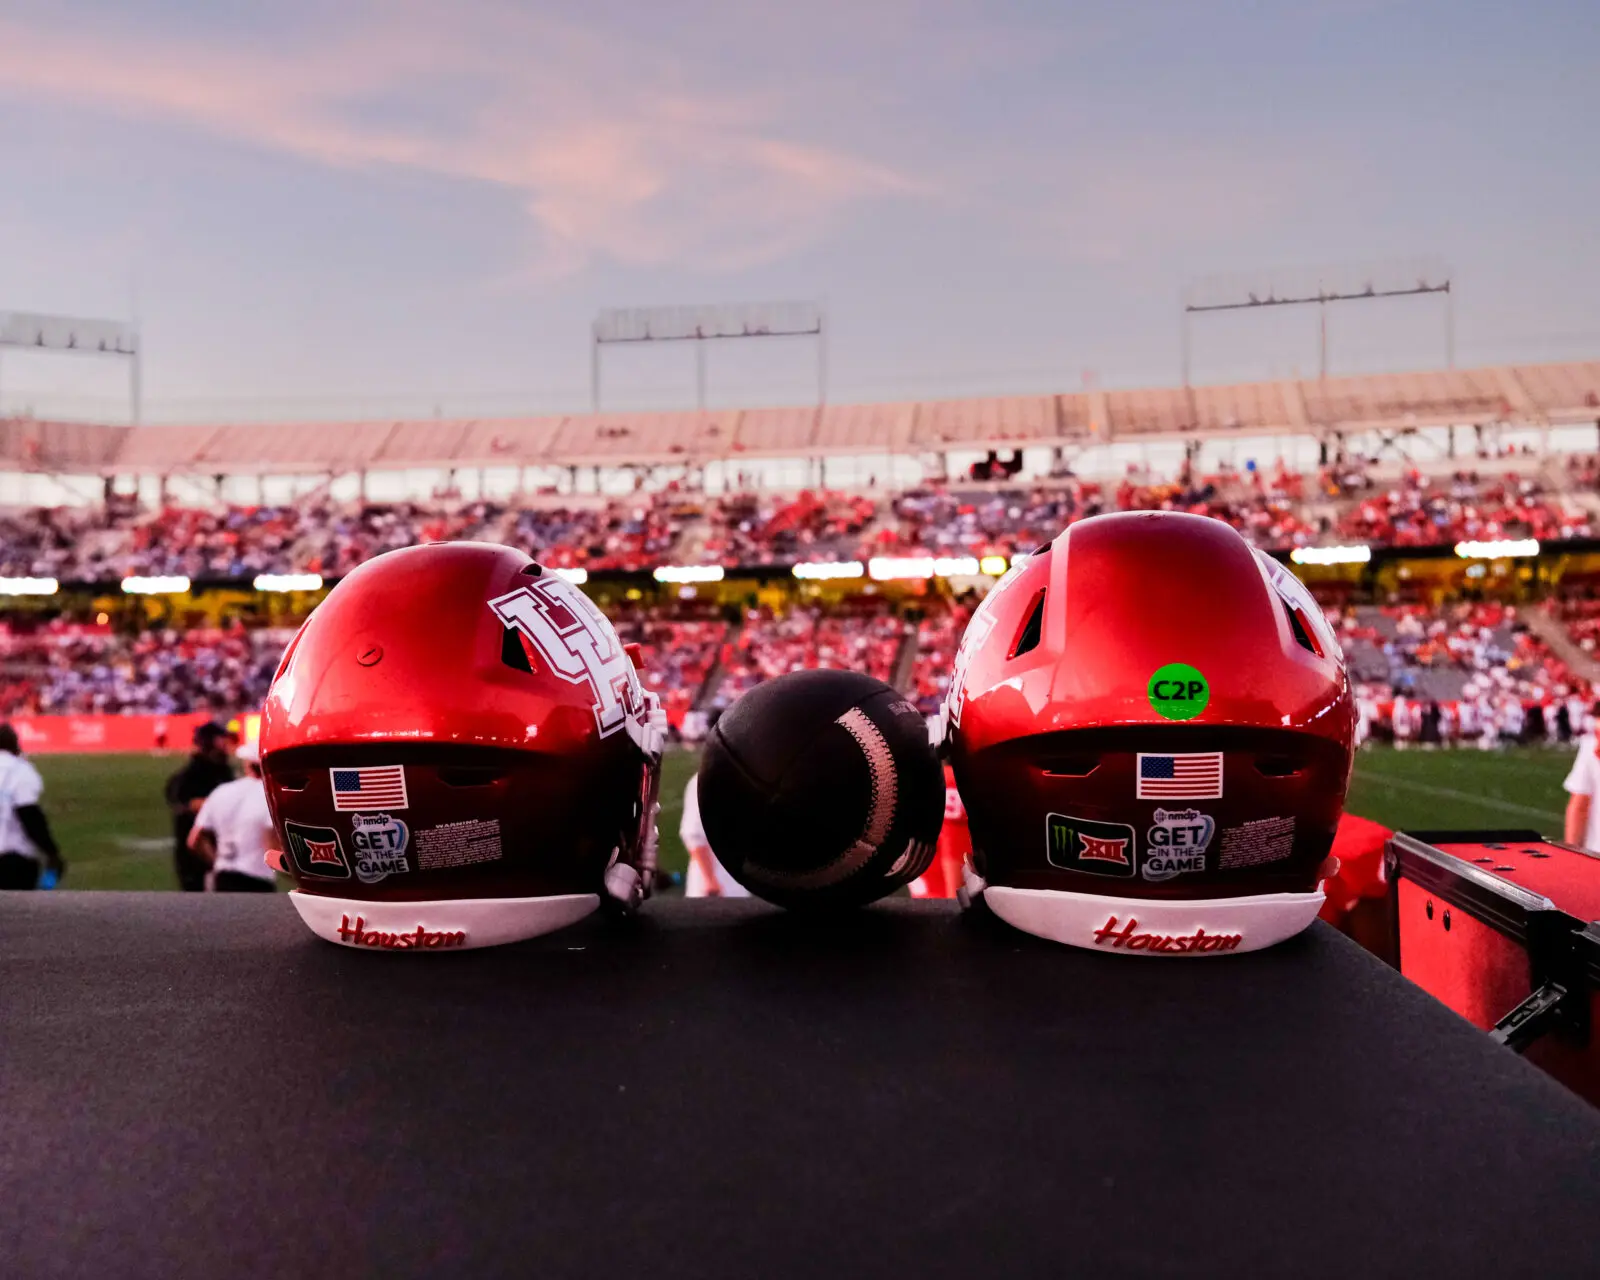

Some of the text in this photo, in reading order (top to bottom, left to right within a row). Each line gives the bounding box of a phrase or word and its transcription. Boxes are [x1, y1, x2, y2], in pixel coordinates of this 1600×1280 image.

[1153, 680, 1204, 700] C2P
[363, 817, 389, 826] nmdp
[1168, 811, 1198, 821] nmdp
[435, 819, 479, 829] WARNING
[353, 830, 397, 849] GET
[1150, 826, 1204, 846] GET
[361, 850, 395, 860] IN THE
[1157, 849, 1195, 857] IN THE
[359, 860, 407, 872] GAME
[1149, 858, 1204, 871] GAME
[337, 914, 466, 949] Houston
[1093, 916, 1242, 953] Houston
